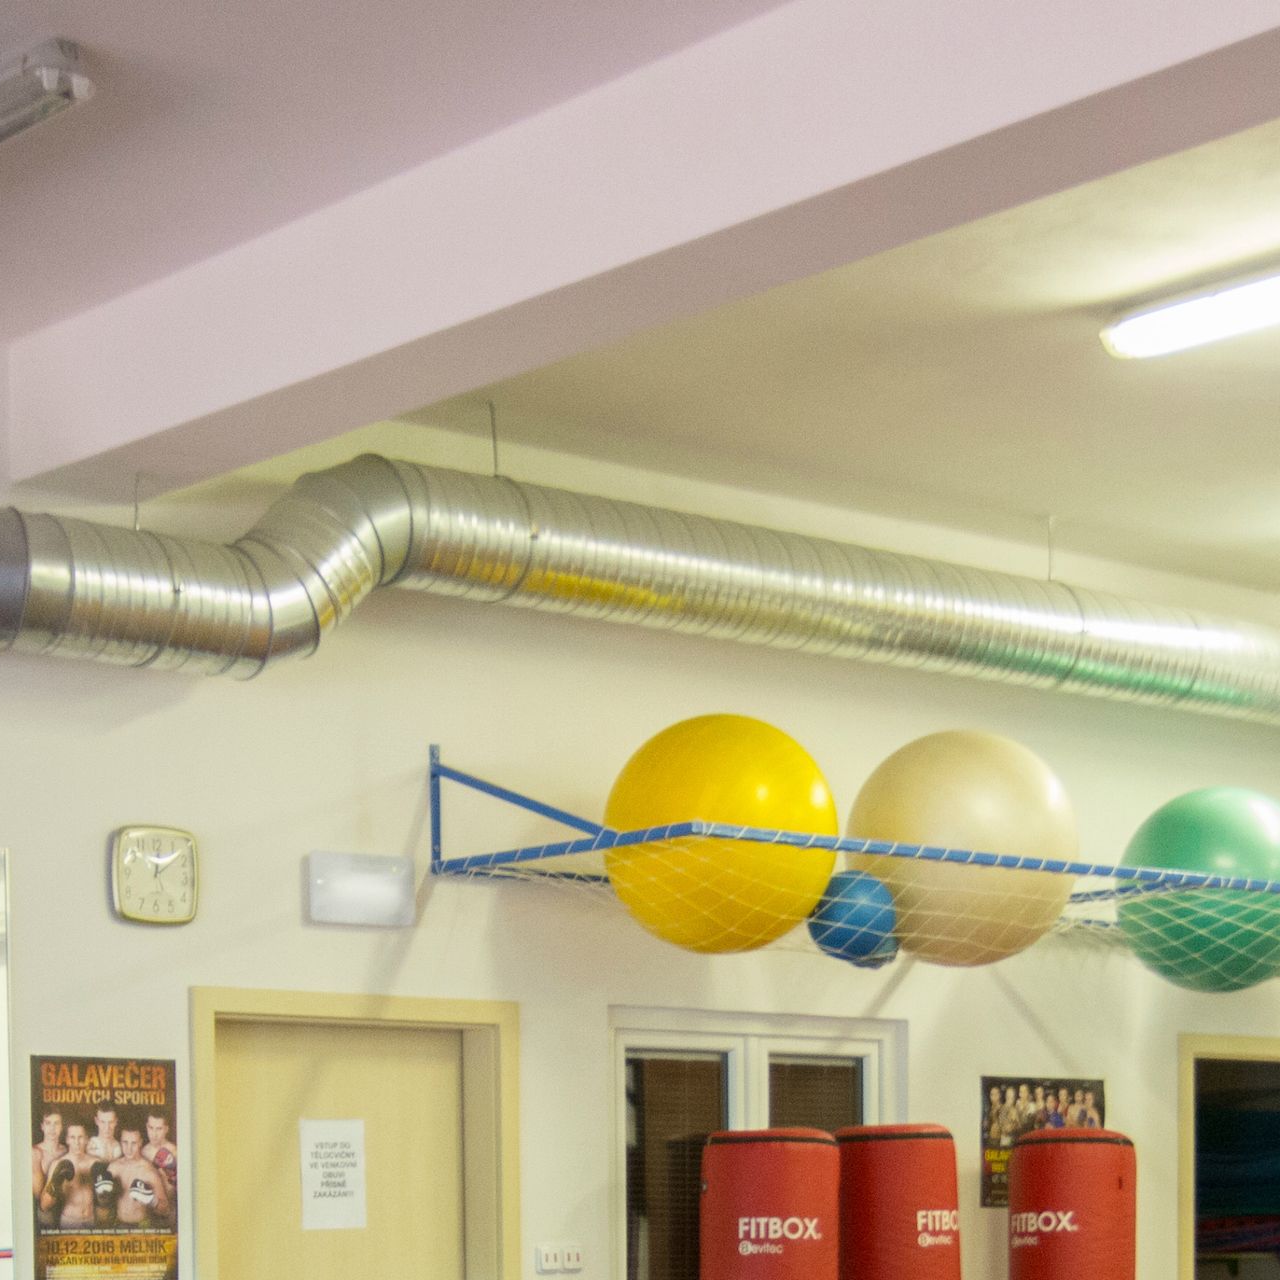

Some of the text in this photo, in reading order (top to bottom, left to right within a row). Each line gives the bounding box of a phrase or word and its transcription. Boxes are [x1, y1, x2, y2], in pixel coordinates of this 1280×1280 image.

[152, 839, 162, 852] 12
[153, 900, 160, 913] 6
[167, 900, 175, 914] 5
[41, 1060, 167, 1089] GALAVEČER
